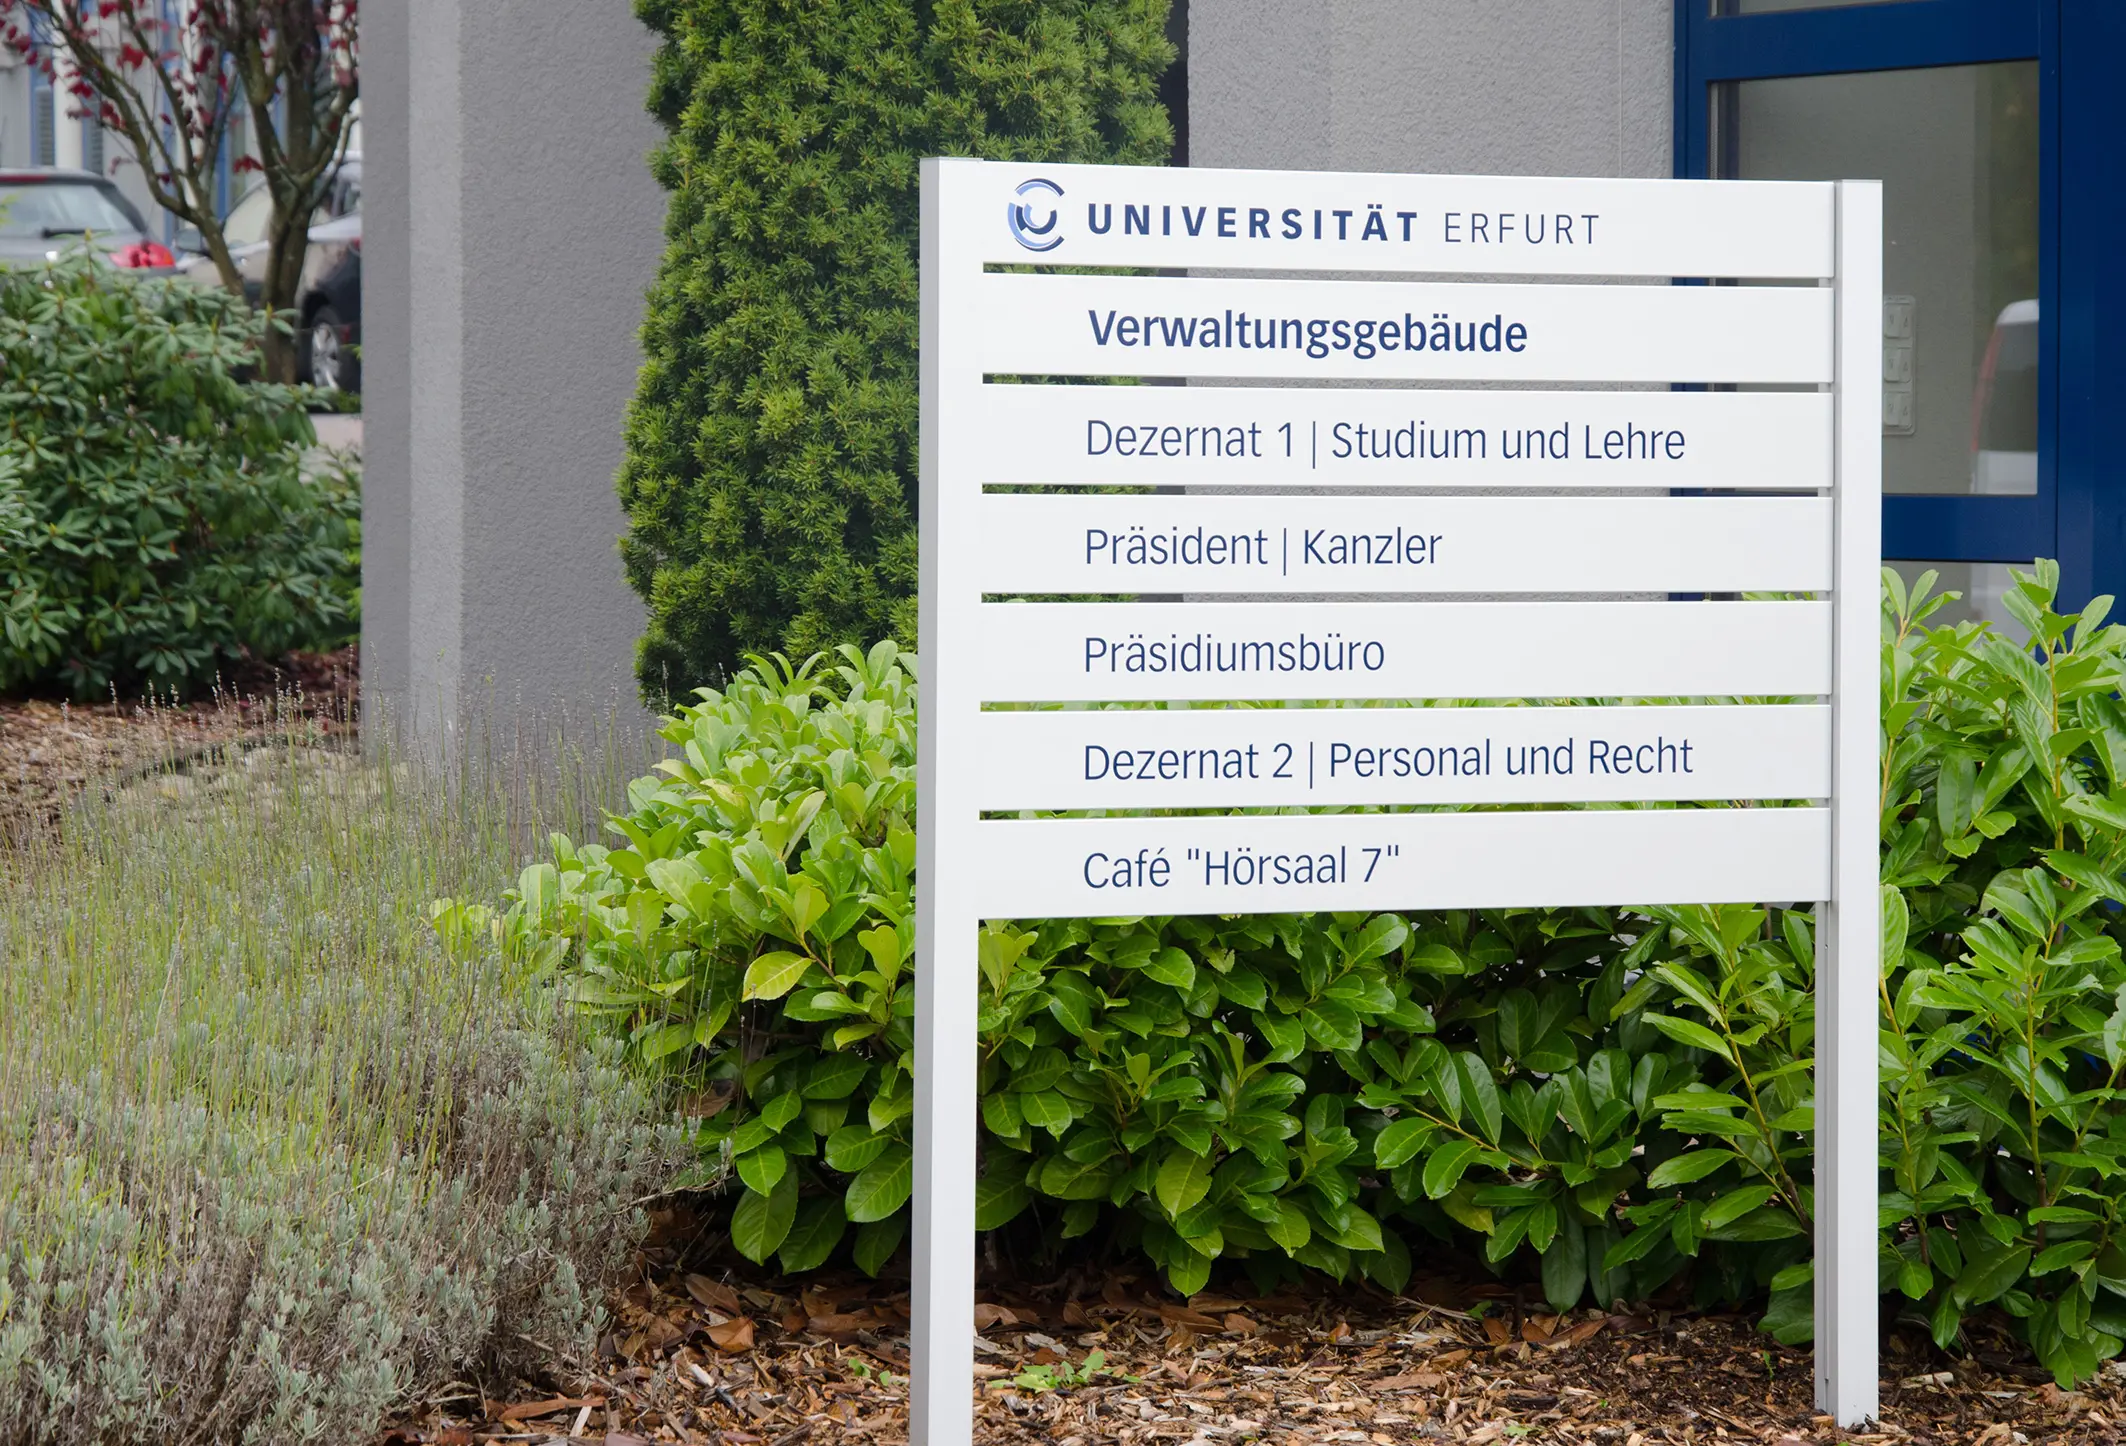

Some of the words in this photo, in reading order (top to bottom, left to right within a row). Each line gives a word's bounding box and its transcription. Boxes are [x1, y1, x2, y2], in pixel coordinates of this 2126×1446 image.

[1088, 203, 1418, 242] UNIVERSITÄT
[1445, 212, 1600, 245] ERFURT
[1088, 309, 1528, 360] Verwaltungsgebäude
[1087, 419, 1262, 458] Dezernat
[1278, 422, 1291, 458] 1
[1332, 420, 1486, 459] Studium
[1502, 421, 1569, 460] und
[1585, 421, 1686, 460] Lehre
[1086, 525, 1269, 565] Präsident
[1304, 526, 1443, 565] Kanzler
[1085, 632, 1385, 673] Präsidiumsbüro
[1084, 743, 1260, 781] Dezernat
[1272, 742, 1293, 778] 2
[1330, 738, 1491, 778] Personal
[1506, 737, 1574, 776] und
[1589, 736, 1694, 775] Recht
[1083, 847, 1171, 889] Café
[1187, 845, 1346, 886] "Hörsaal
[1361, 844, 1399, 883] 7"
